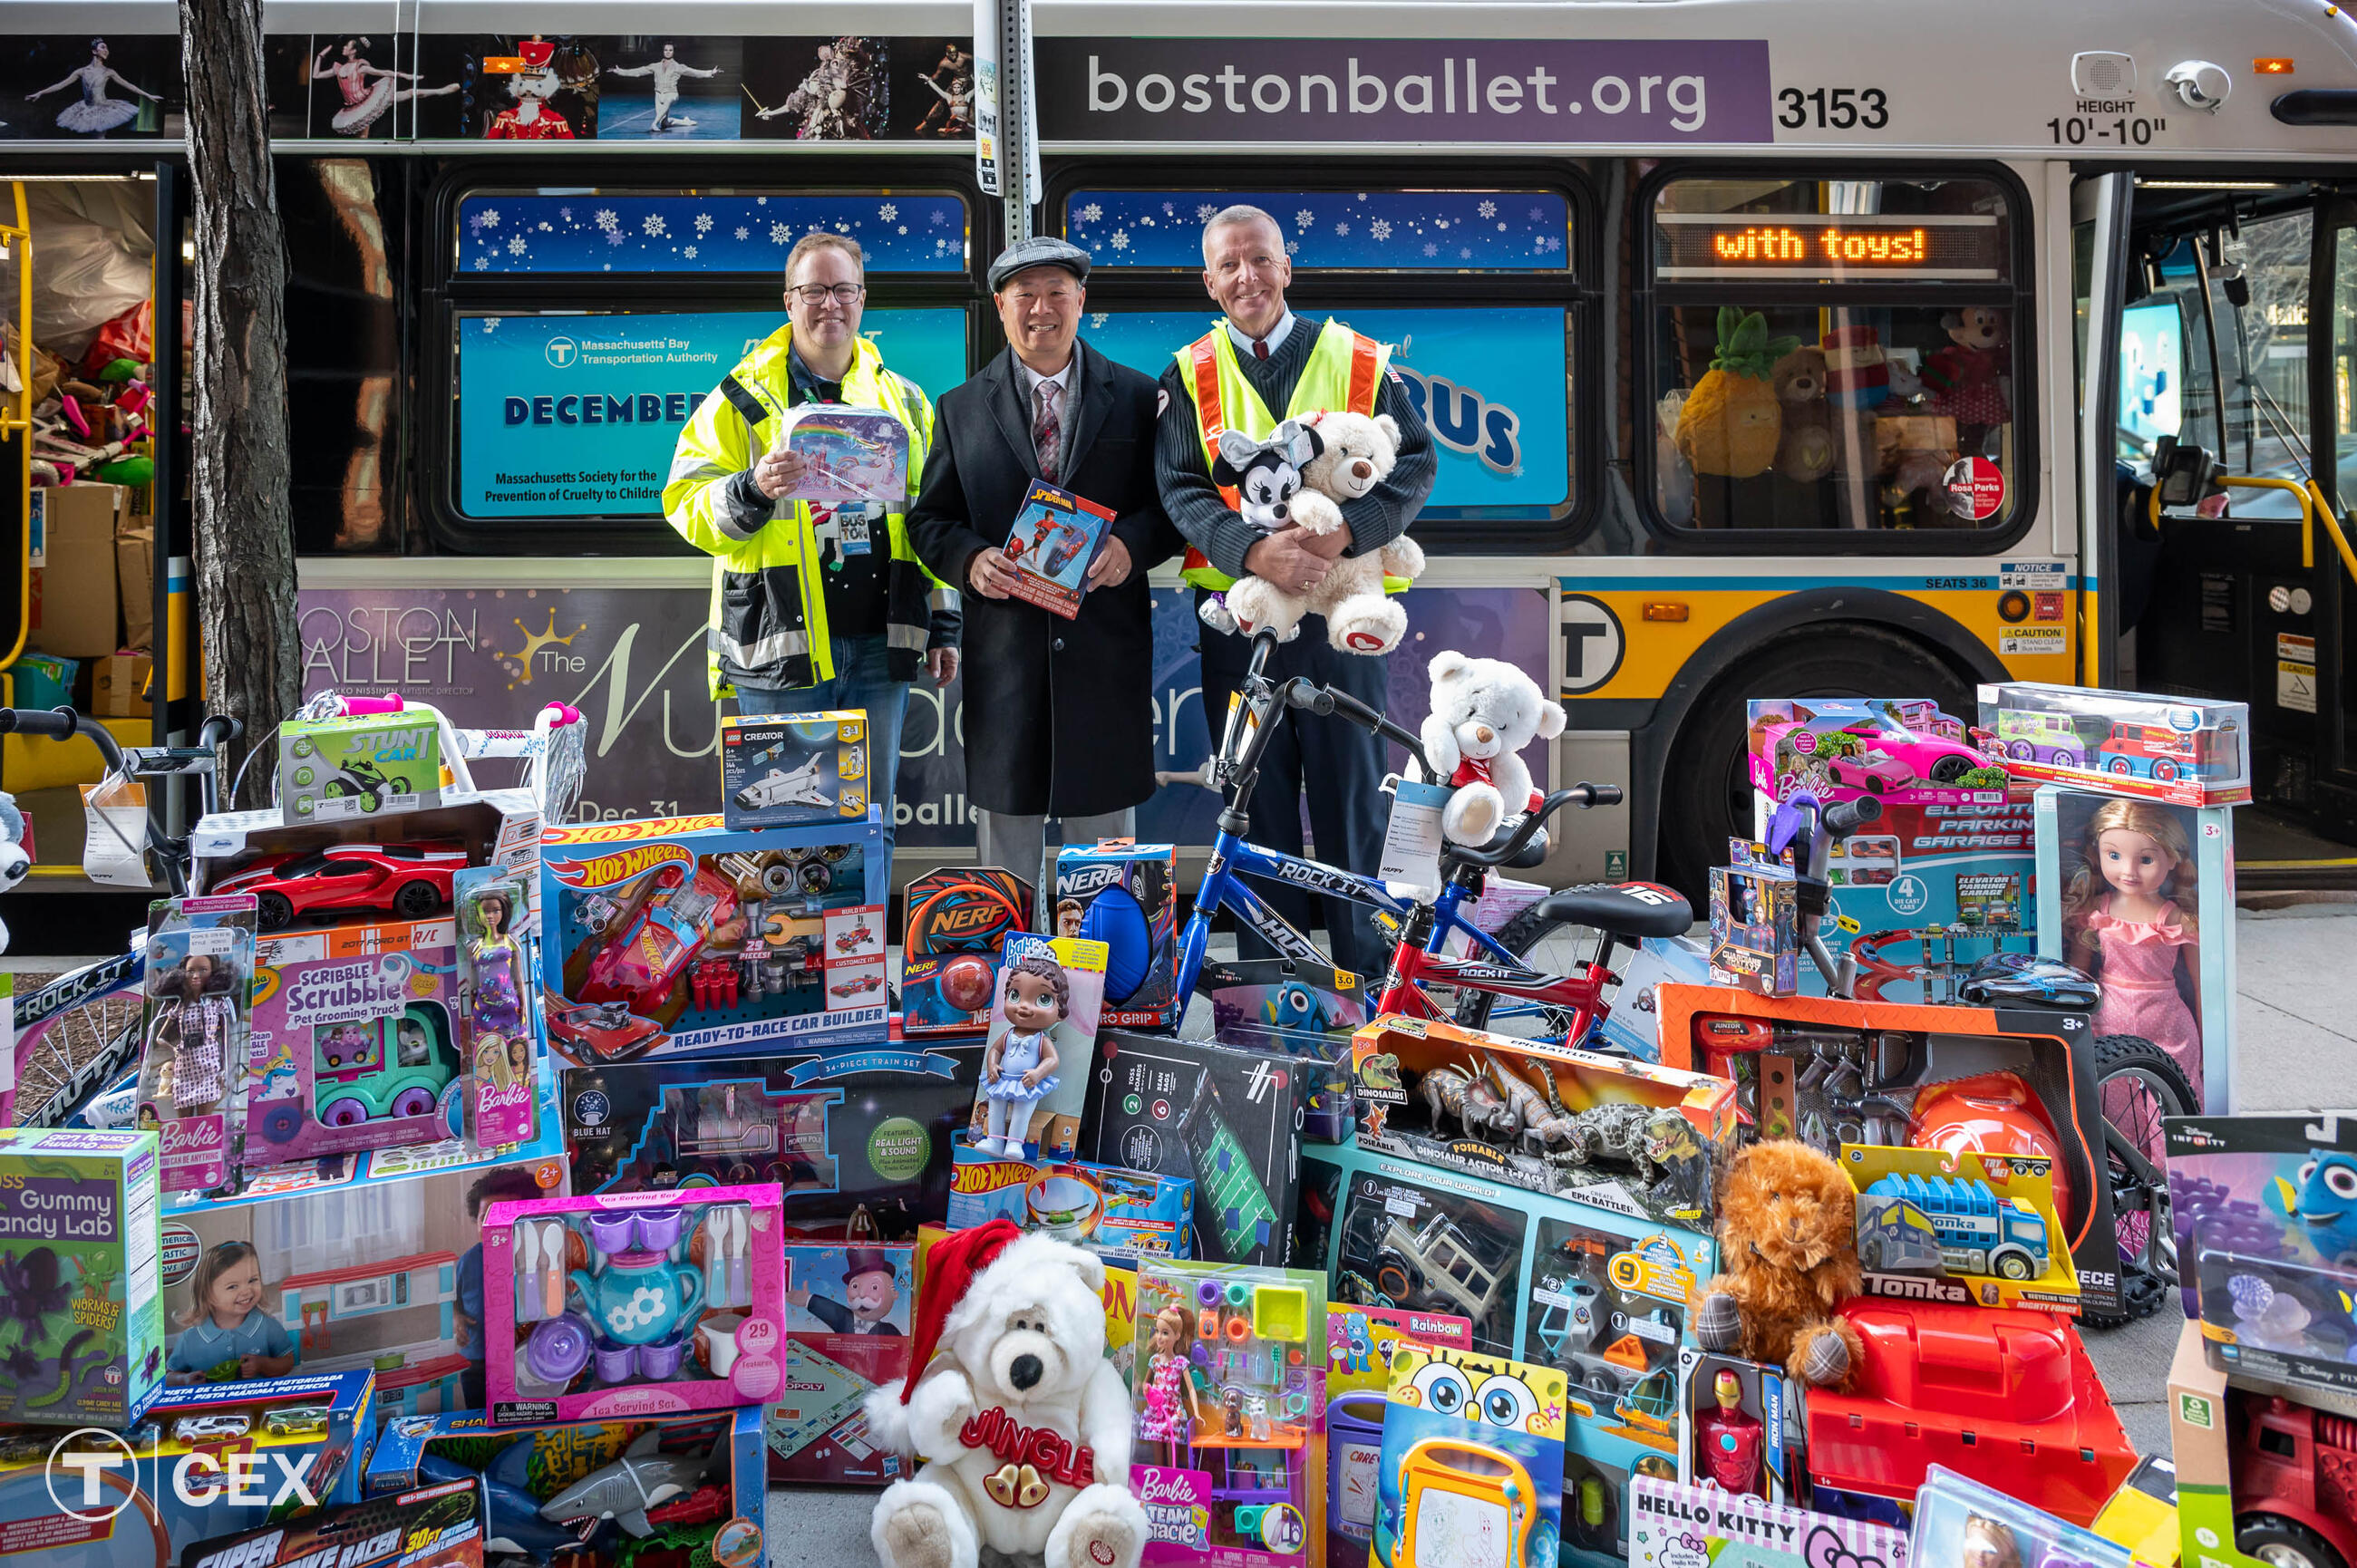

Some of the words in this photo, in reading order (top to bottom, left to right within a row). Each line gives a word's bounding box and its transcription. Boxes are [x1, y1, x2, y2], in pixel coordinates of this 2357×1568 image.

[1088, 54, 1708, 135] bostonballet.org
[1778, 88, 1889, 130] 3153
[2076, 100, 2136, 114] HEIGHT
[1716, 227, 1803, 260] with
[1820, 227, 1925, 261] toys!
[581, 339, 665, 352] Massachusetts
[669, 338, 690, 353] Bay
[581, 353, 664, 365] Transportation
[665, 351, 718, 365] Authority
[495, 472, 577, 485] Massachusetts
[577, 470, 618, 487] Society
[620, 470, 636, 483] for
[637, 469, 657, 482] the
[485, 489, 543, 502] Prevention
[546, 489, 559, 500] of
[562, 488, 603, 503] Cruelty
[606, 489, 617, 499] to
[1950, 484, 1973, 492] Rosa
[1974, 483, 2000, 491] Parks
[1031, 488, 1073, 511] SPIDER-MAN
[841, 515, 867, 528] BOS
[2014, 564, 2052, 573] NOTICE
[1925, 578, 1967, 588] SEATS
[1971, 578, 1987, 588] 36
[2014, 629, 2061, 637] CAUTION
[538, 651, 586, 673] The
[355, 687, 399, 695] NISSINEN
[401, 687, 434, 695] ARTISTIC
[436, 686, 475, 695] DIRECTOR
[342, 727, 435, 760] STUNT
[726, 733, 741, 741] LEGO
[744, 731, 784, 740] CREATOR
[374, 748, 416, 763] CAR
[2206, 825, 2221, 837] 3+
[1913, 835, 2022, 848] GARAGE
[505, 850, 535, 866] USB
[580, 858, 625, 886] HOT
[1058, 866, 1124, 895] NERF
[1278, 861, 1336, 888] ROCK
[1335, 878, 1366, 895] IT
[1621, 886, 1673, 906] 16
[1898, 878, 1915, 897] 4
[929, 905, 1006, 935] NERF
[341, 940, 364, 949] 2017
[366, 937, 395, 946] FORD
[396, 935, 410, 944] GT
[747, 940, 762, 953] 29
[836, 959, 865, 968] CUSTOMIZE
[905, 959, 938, 976] NERF
[301, 963, 369, 986] SCRIBBLE
[1337, 976, 1353, 985] 3.0
[1458, 968, 1494, 978] ROCK
[1496, 968, 1511, 978] IT
[25, 975, 90, 1021] ROCK
[94, 959, 128, 987] IT
[288, 975, 402, 1012] Scrubbie
[294, 1014, 312, 1025] Pet
[316, 1009, 368, 1023] Grooming
[370, 1002, 400, 1015] Truck
[1121, 1012, 1153, 1025] GRIP
[674, 1021, 789, 1049] READY-TO-RACE
[791, 1017, 820, 1031] CAR
[821, 1008, 884, 1028] BUILDER
[2063, 1019, 2085, 1031] 3+
[1511, 1040, 1540, 1051] EPIC
[872, 1058, 900, 1067] TRAIN
[904, 1059, 921, 1068] SET
[42, 1028, 131, 1128] HUFFY
[1128, 1068, 1136, 1086] TOSS
[1134, 1063, 1143, 1092] BOARDS
[1163, 1072, 1171, 1092] BAGS
[479, 1082, 529, 1113] Barbie
[1357, 1089, 1406, 1102] DINOSAURS
[160, 1121, 223, 1155] Barbie
[574, 1127, 594, 1137] BLUE
[596, 1127, 611, 1136] HAT
[787, 1137, 805, 1146] NORTH
[805, 1135, 822, 1144] POLE
[2173, 1134, 2226, 1147] INFINITY
[2183, 1125, 2213, 1138] Disney
[875, 1138, 896, 1147] REAL
[897, 1137, 922, 1146] LIGHT
[1358, 1137, 1396, 1152] POSEABLE
[160, 1157, 175, 1166] YOU
[175, 1156, 189, 1165] CAN
[199, 1151, 220, 1163] ANYTHING
[888, 1147, 917, 1156] SOUND
[1417, 1144, 1466, 1166] DINOSAUR
[1466, 1154, 1505, 1174] ACTION
[1452, 1142, 1505, 1165] POSEABLE
[541, 1166, 558, 1178] 2+
[1984, 1158, 2002, 1168] TRY
[957, 1167, 995, 1193] HOT
[1379, 1163, 1423, 1179] EXPLORE
[1423, 1174, 1451, 1187] YOUR
[1990, 1167, 2010, 1178] ME!
[20, 1190, 111, 1216] Gummy
[600, 1195, 616, 1203] Tea
[617, 1193, 658, 1203] Serving
[660, 1192, 678, 1200] Set
[1571, 1190, 1593, 1204] EPIC
[1594, 1196, 1634, 1213] BATTLES!
[1679, 1201, 1691, 1211] Kid
[65, 1214, 112, 1235] Lab
[490, 1235, 509, 1246] 3+
[1619, 1261, 1635, 1282] 9
[1870, 1273, 1966, 1302] Tonka
[72, 1298, 112, 1316] WORMS
[2017, 1301, 2051, 1312] MIGHTY
[2051, 1303, 2079, 1314] FORCE
[2057, 1294, 2079, 1304] TRUCK
[73, 1312, 117, 1331] SPIDERS!
[750, 1322, 769, 1337] 29
[1411, 1317, 1463, 1335] Rainbow
[1399, 1342, 1434, 1354] nickelodeon
[2297, 1363, 2333, 1381] Disney
[141, 1382, 163, 1405] THAMES
[163, 1387, 193, 1397] PISTA
[195, 1386, 208, 1394] DE
[209, 1380, 270, 1394] CARRERAS
[270, 1373, 344, 1388] MOTORIZADA
[195, 1390, 228, 1401] PISTA
[229, 1386, 275, 1399] MÁXIMA
[276, 1380, 331, 1394] POTENCIA
[142, 1389, 163, 1411] KOSMOS
[592, 1407, 611, 1416] Tea
[613, 1401, 655, 1415] Serving
[658, 1399, 676, 1410] Set
[1770, 1393, 1780, 1421] MAN
[1771, 1422, 1780, 1448] IRON
[959, 1407, 1096, 1489] JINGLE
[1140, 1468, 1198, 1502] Barbie
[1145, 1505, 1192, 1526] TEAM
[1637, 1493, 1711, 1524] HELLO
[1717, 1503, 1796, 1544] KITTY
[337, 1527, 403, 1568] RACER
[405, 1526, 443, 1555] 30FT
[1891, 1546, 1907, 1560] 6+
